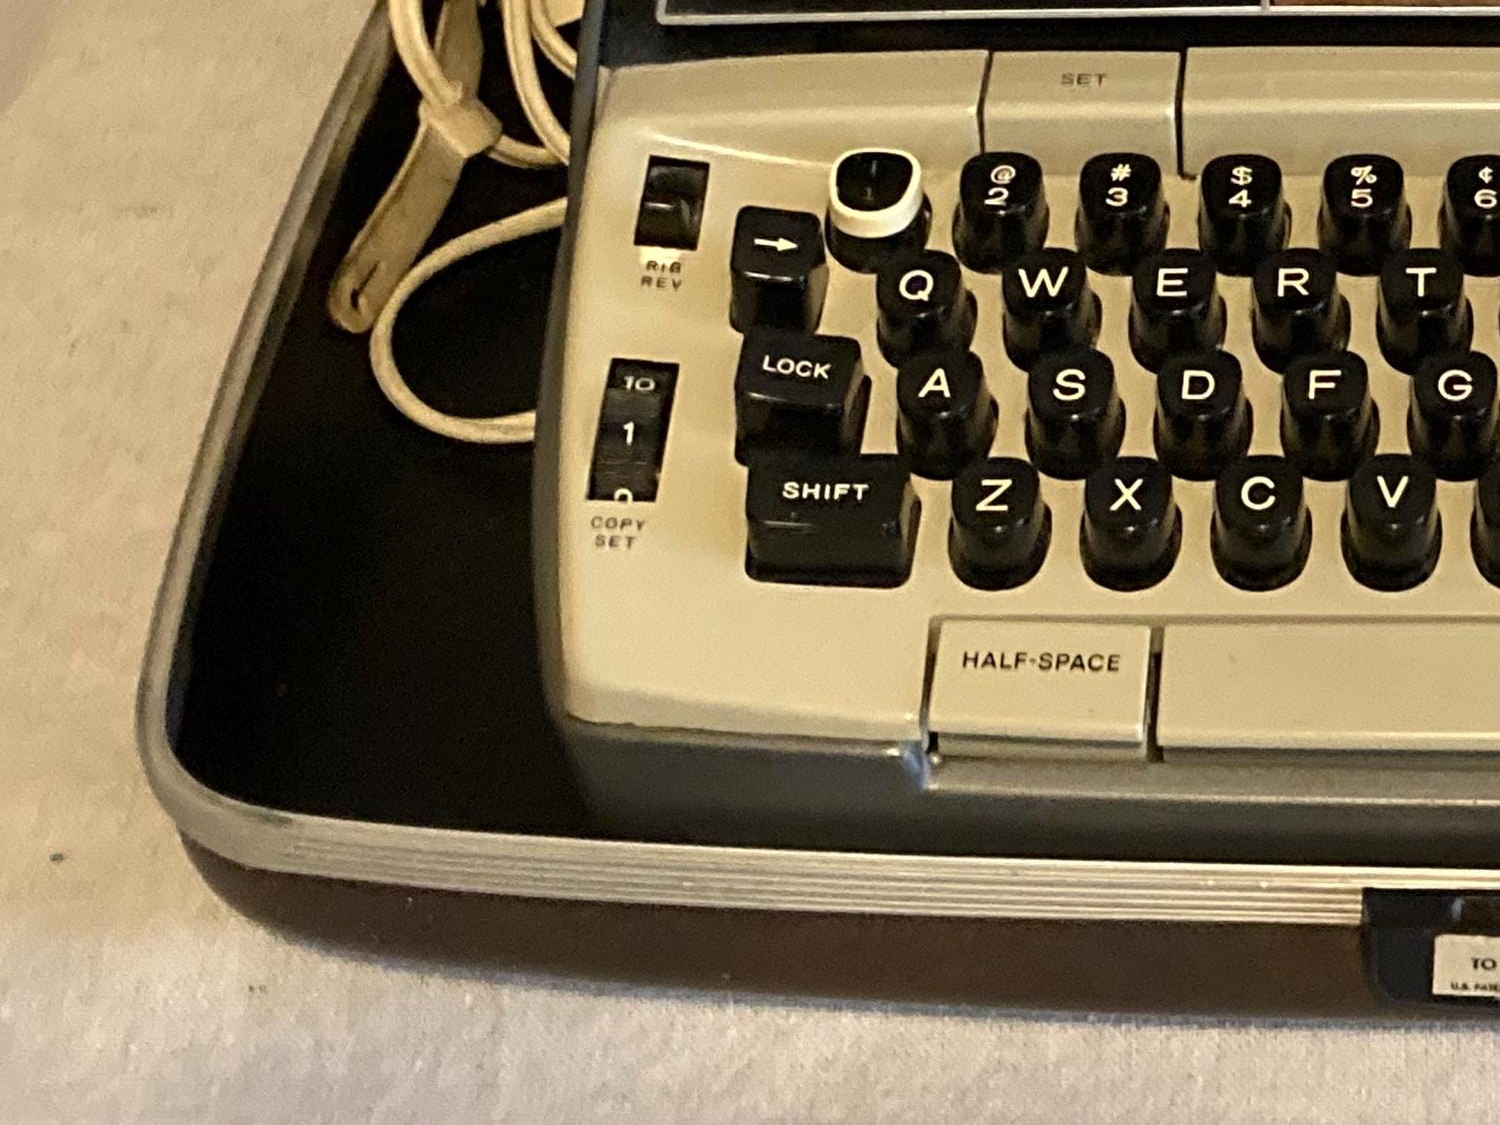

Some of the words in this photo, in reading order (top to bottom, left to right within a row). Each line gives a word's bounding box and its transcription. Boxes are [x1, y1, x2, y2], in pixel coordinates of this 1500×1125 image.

[1061, 73, 1106, 86] SET
[990, 164, 1016, 185] @
[1110, 163, 1132, 182] #
[1230, 165, 1253, 186] $
[1350, 165, 1378, 186] %
[1478, 166, 1493, 184] ¢
[984, 186, 1009, 206] 2
[1105, 187, 1129, 207] 3
[1228, 189, 1252, 208] 4
[1350, 188, 1373, 208] 5
[1473, 188, 1498, 209] 6
[641, 276, 682, 291] REV
[898, 269, 934, 302] Q
[1017, 266, 1069, 298] W
[1156, 267, 1189, 297] E
[1277, 267, 1310, 297] R
[1405, 267, 1437, 298] T
[762, 354, 831, 380] LOCK
[623, 376, 656, 391] 10
[917, 367, 951, 398] A
[1052, 368, 1086, 401] S
[1181, 369, 1216, 400] D
[1308, 369, 1342, 400] F
[1437, 369, 1473, 402] G
[623, 421, 635, 446] 1
[782, 481, 869, 501] SHIFT
[975, 478, 1013, 512] Z
[1109, 478, 1144, 511] X
[1240, 475, 1276, 511] C
[1376, 475, 1409, 508] V
[590, 516, 646, 531] COPY
[595, 535, 636, 550] SET
[962, 651, 1121, 672] HALF-SPACE
[1472, 957, 1497, 971] TO
